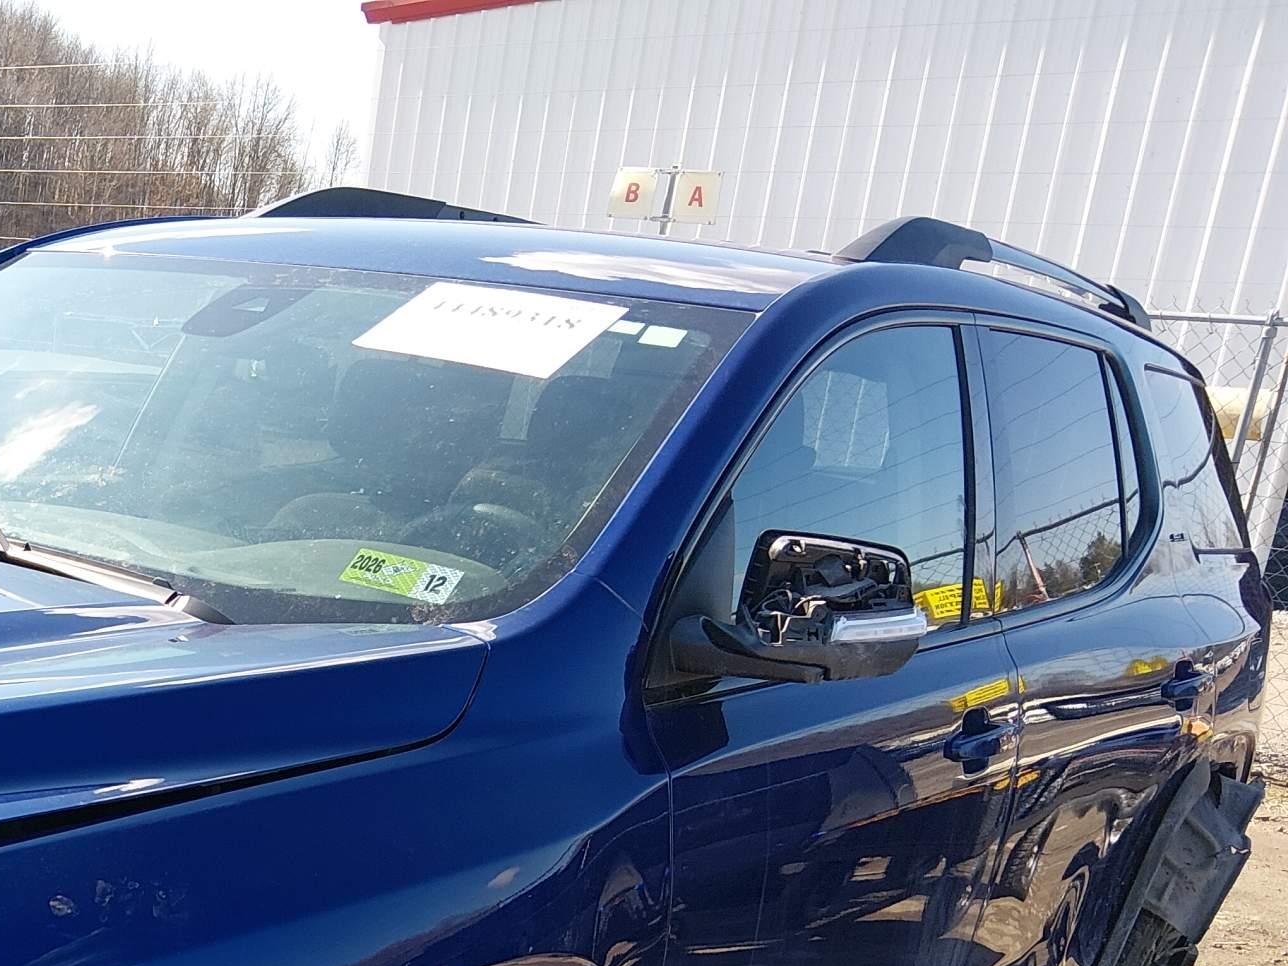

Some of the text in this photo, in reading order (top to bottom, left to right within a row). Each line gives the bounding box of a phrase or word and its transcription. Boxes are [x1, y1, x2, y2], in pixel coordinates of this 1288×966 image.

[624, 182, 640, 203] B
[688, 186, 703, 208] A
[350, 554, 386, 574] 2026
[423, 574, 448, 595] 12
